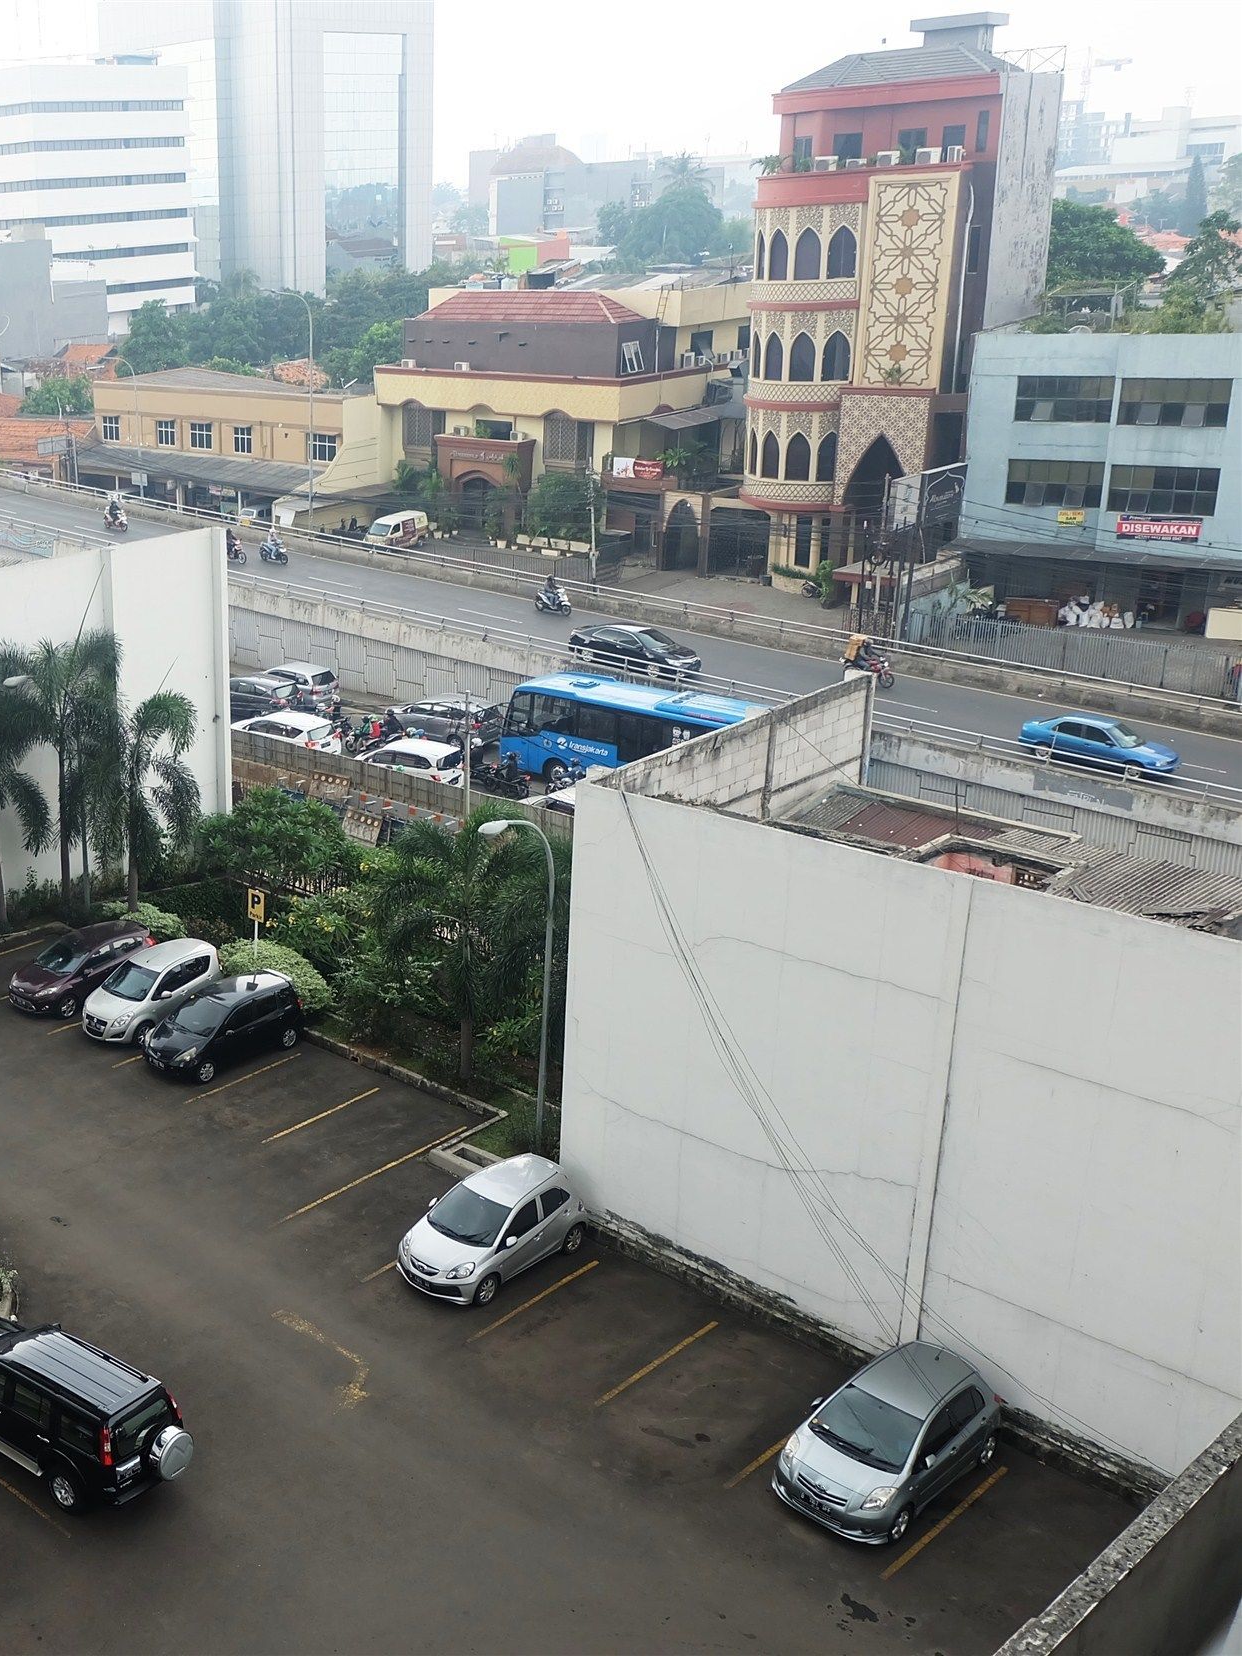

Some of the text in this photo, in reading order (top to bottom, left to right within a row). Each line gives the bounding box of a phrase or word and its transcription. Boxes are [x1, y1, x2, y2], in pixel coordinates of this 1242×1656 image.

[1121, 523, 1197, 535] DISEWAKAN
[568, 741, 609, 757] transjakarta
[251, 893, 261, 909] P
